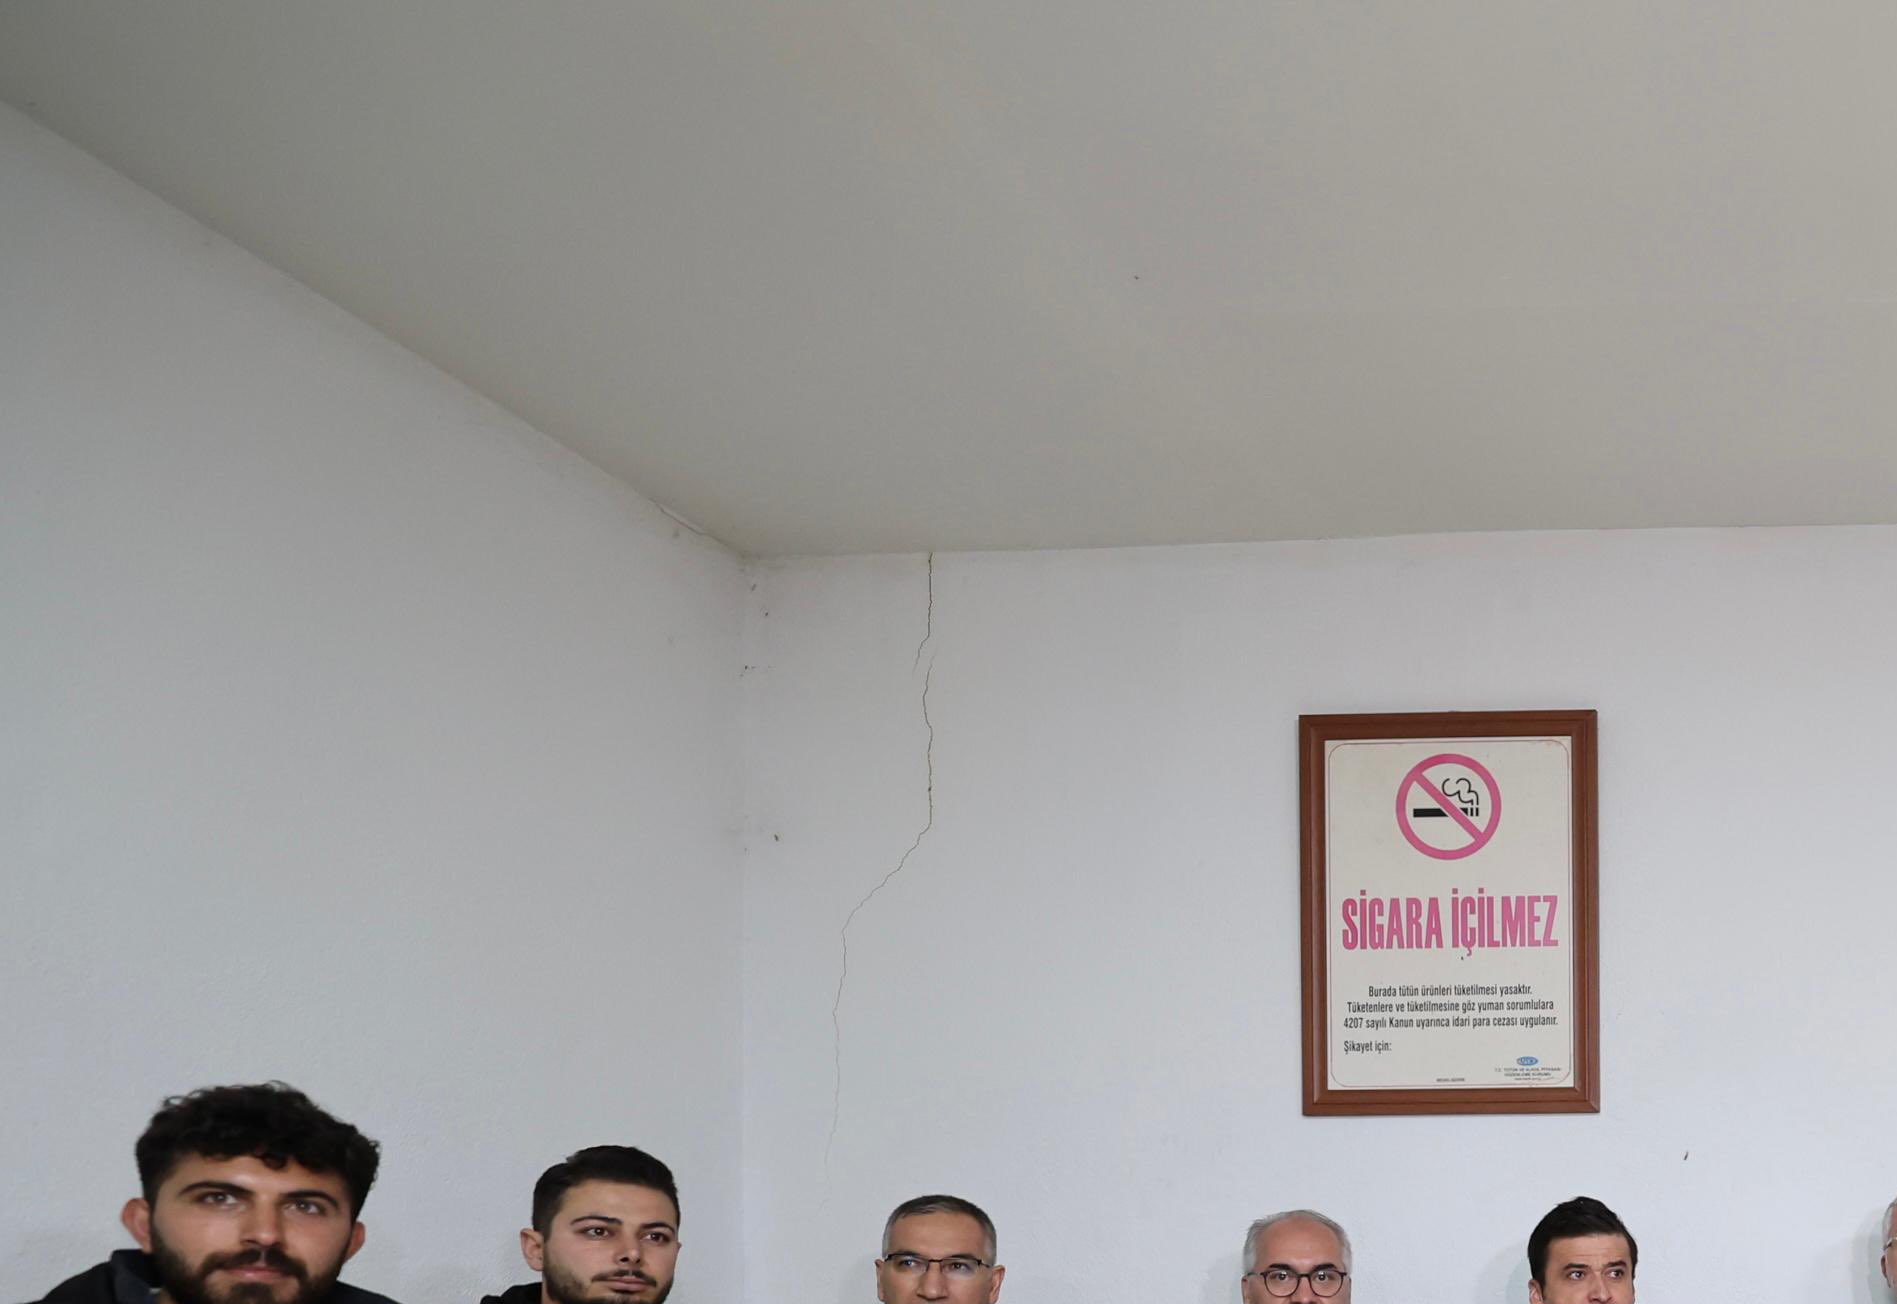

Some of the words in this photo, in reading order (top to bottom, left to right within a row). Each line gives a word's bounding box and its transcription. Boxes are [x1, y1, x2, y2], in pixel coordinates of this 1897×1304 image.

[1342, 889, 1443, 950] SİGARA
[1452, 887, 1559, 956] İÇİLMEZ
[1368, 985, 1397, 997] Burada
[1399, 985, 1419, 996] tütün
[1421, 985, 1452, 996] ürünleri
[1454, 984, 1498, 996] tüketilmesi
[1499, 984, 1533, 997] yasaktır.
[1347, 1001, 1394, 1013] Tüketenlere
[1395, 1003, 1405, 1012] ve
[1407, 1001, 1460, 1012] tüketilmesine
[1462, 1000, 1476, 1014] göz
[1478, 1001, 1504, 1013] yuman
[1506, 999, 1554, 1011] sorumlulara
[1344, 1017, 1364, 1029] 4207
[1366, 1018, 1387, 1031] sayılı
[1389, 1017, 1414, 1028] Kanun
[1415, 1018, 1450, 1030] uyarınca
[1452, 1016, 1470, 1027] idari
[1472, 1017, 1491, 1029] para
[1492, 1016, 1518, 1027] cezası
[1519, 1014, 1559, 1028] uygulanır.
[1344, 1040, 1373, 1055] Şikayet
[1374, 1040, 1392, 1054] için:
